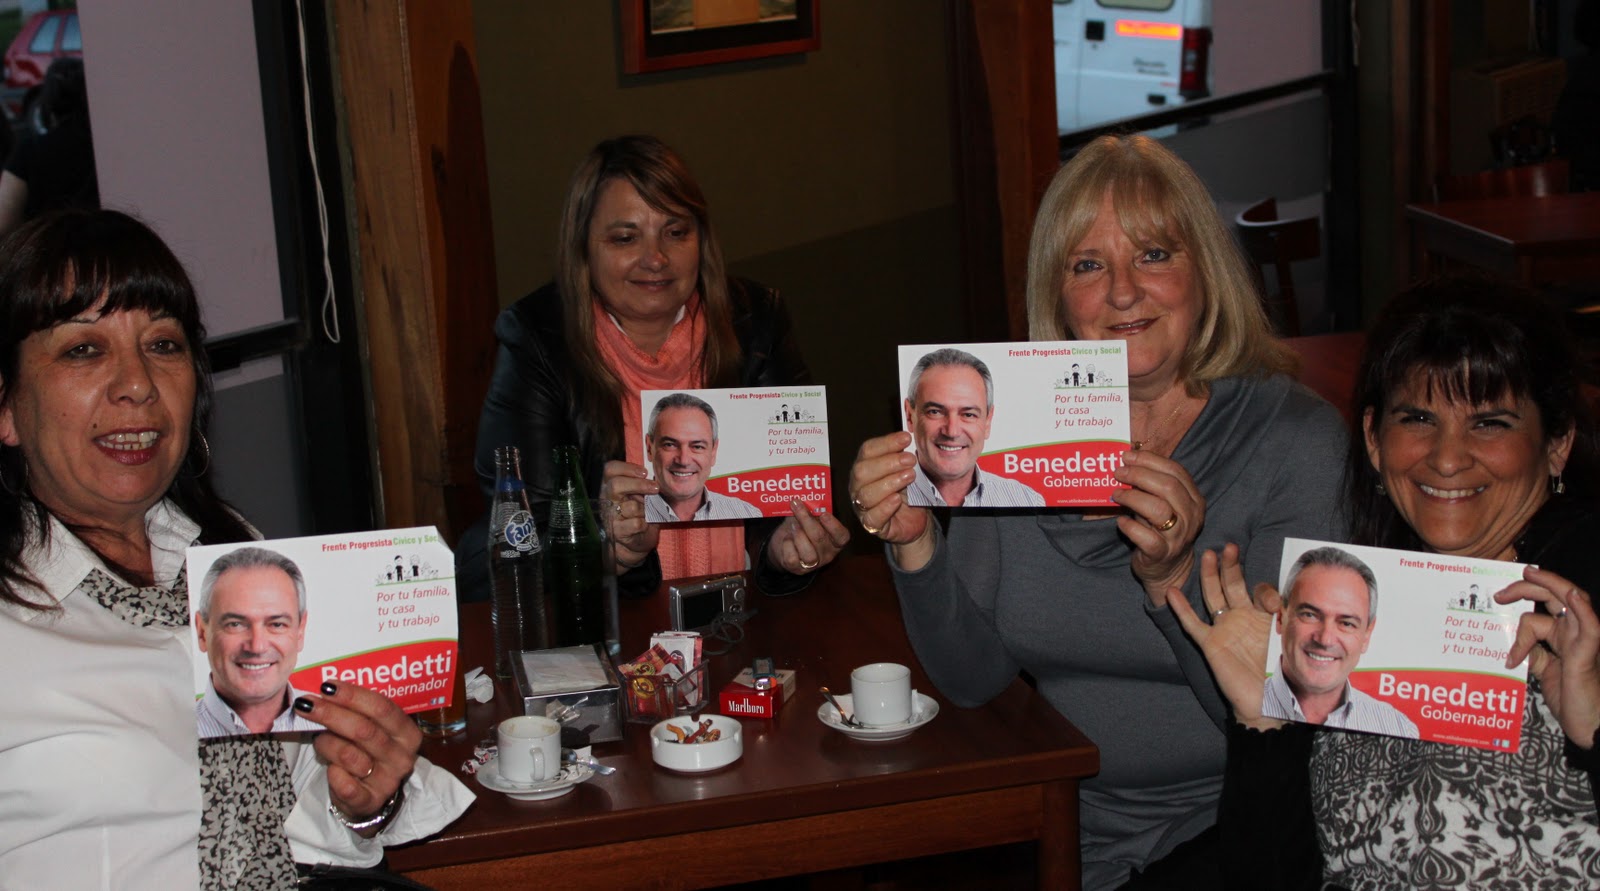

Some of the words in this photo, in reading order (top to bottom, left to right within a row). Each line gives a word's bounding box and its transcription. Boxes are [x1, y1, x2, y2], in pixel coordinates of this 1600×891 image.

[1008, 349, 1031, 357] Frente
[1032, 348, 1071, 358] Progresista
[1100, 346, 1122, 354] Social
[1054, 393, 1072, 404] Por
[1074, 394, 1084, 403] tu
[1087, 392, 1124, 404] familia,
[1055, 406, 1066, 415] tu
[1068, 407, 1090, 415] casa
[1055, 420, 1061, 429] y
[1064, 418, 1074, 427] tu
[1077, 416, 1113, 428] trabajo
[768, 428, 781, 436] Por
[794, 427, 824, 436] familia,
[768, 448, 774, 456] y
[776, 447, 785, 455] tu
[787, 446, 816, 455] trabajo
[727, 472, 826, 493] Benedetti
[321, 543, 348, 552] Frente
[349, 538, 393, 551] Progresista
[1399, 558, 1425, 569] Frente
[1426, 561, 1471, 574] Progresista
[376, 591, 395, 602] Por
[398, 590, 409, 600] tu
[413, 586, 451, 598] familia,
[378, 606, 389, 616] tu
[392, 604, 415, 614] casa
[378, 620, 384, 632] y
[388, 618, 399, 629] tu
[402, 614, 440, 629] trabajo
[1444, 615, 1465, 627] Por
[1467, 618, 1480, 629] tu
[1444, 629, 1456, 640] tu
[1459, 632, 1484, 643] casa
[1442, 644, 1450, 654] y
[1453, 643, 1465, 654] tu
[1468, 643, 1510, 661] trabajo
[321, 650, 451, 686] Benedetti
[1378, 673, 1518, 714] Benedetti
[728, 698, 765, 714] Marlboro
[1420, 705, 1513, 730] Gobernador
